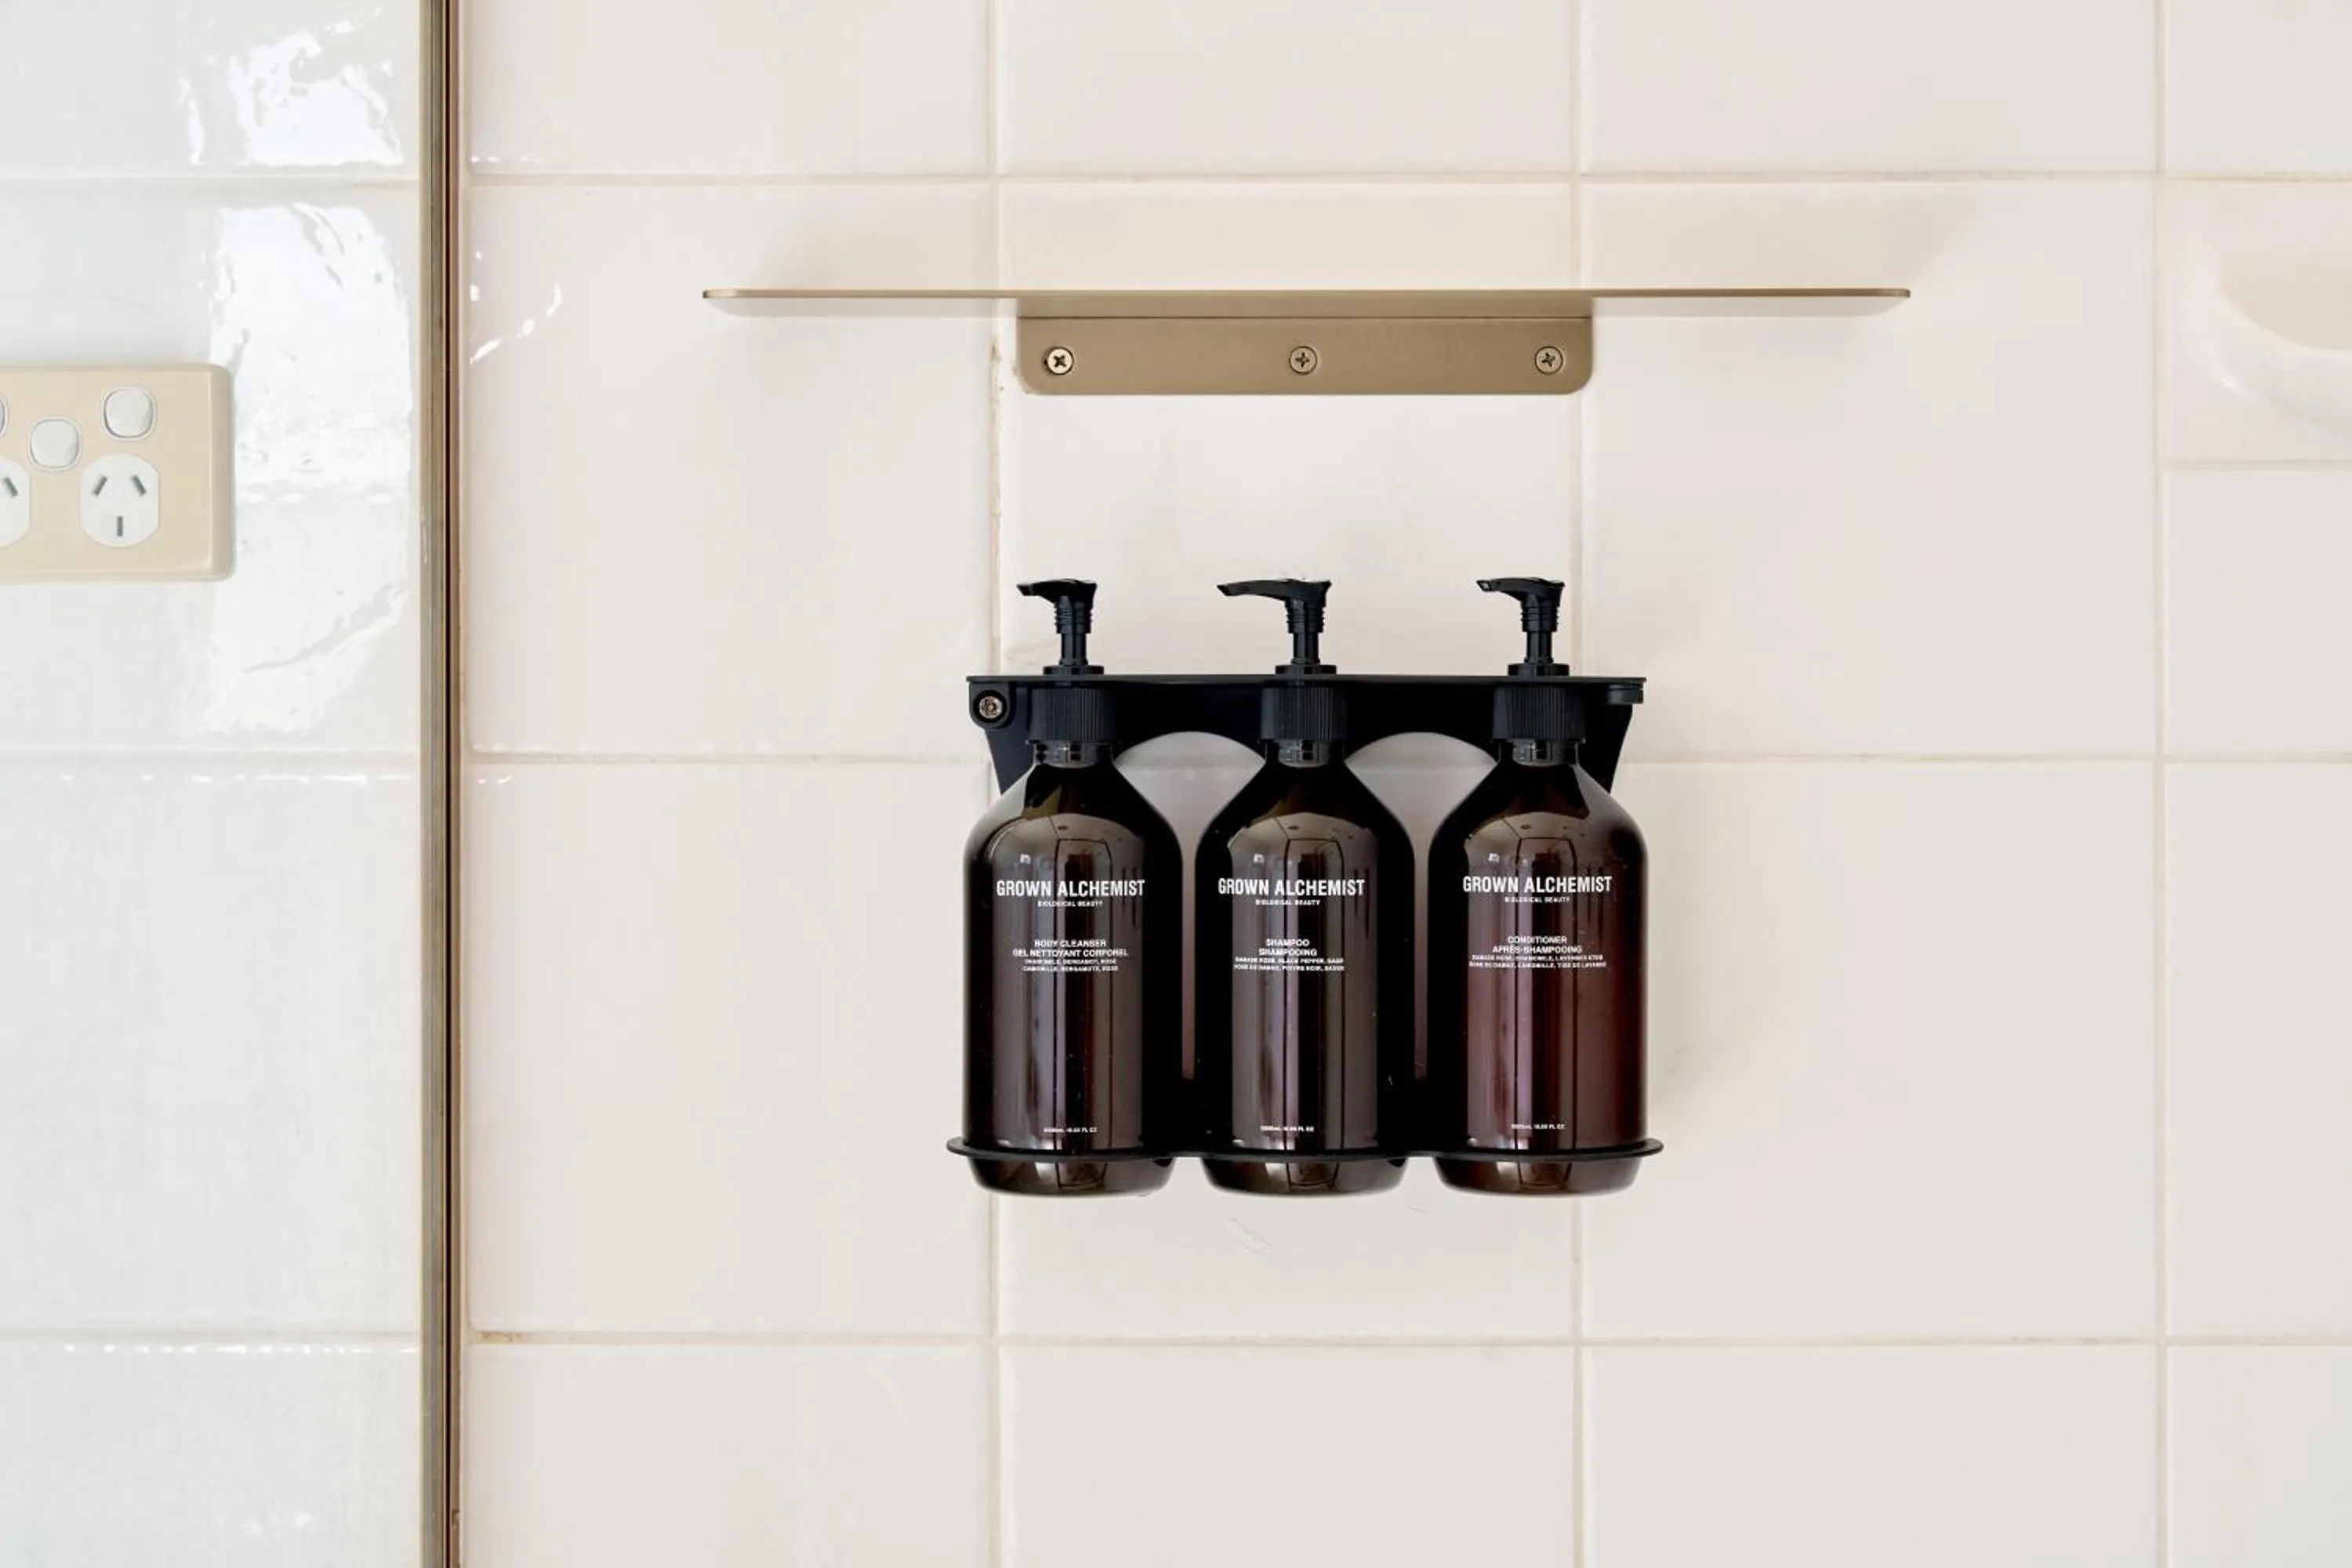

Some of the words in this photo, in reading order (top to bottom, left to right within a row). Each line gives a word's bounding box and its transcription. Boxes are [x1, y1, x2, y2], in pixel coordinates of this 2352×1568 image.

[996, 880, 1051, 896] GROWN
[1058, 880, 1145, 896] ALCHEMIST
[1218, 878, 1269, 895] GROWN
[1275, 880, 1365, 895] ALCHEMIST
[1463, 876, 1519, 892] GROWN
[1524, 876, 1613, 892] ALCHEMIST
[1034, 939, 1057, 948] BODY
[1060, 939, 1106, 948] CLEANSER
[1013, 949, 1029, 957] GEL
[1030, 949, 1080, 957] NETTOYANT
[1083, 949, 1128, 957] CORPOREL
[1258, 948, 1317, 956] SHAMPOOING
